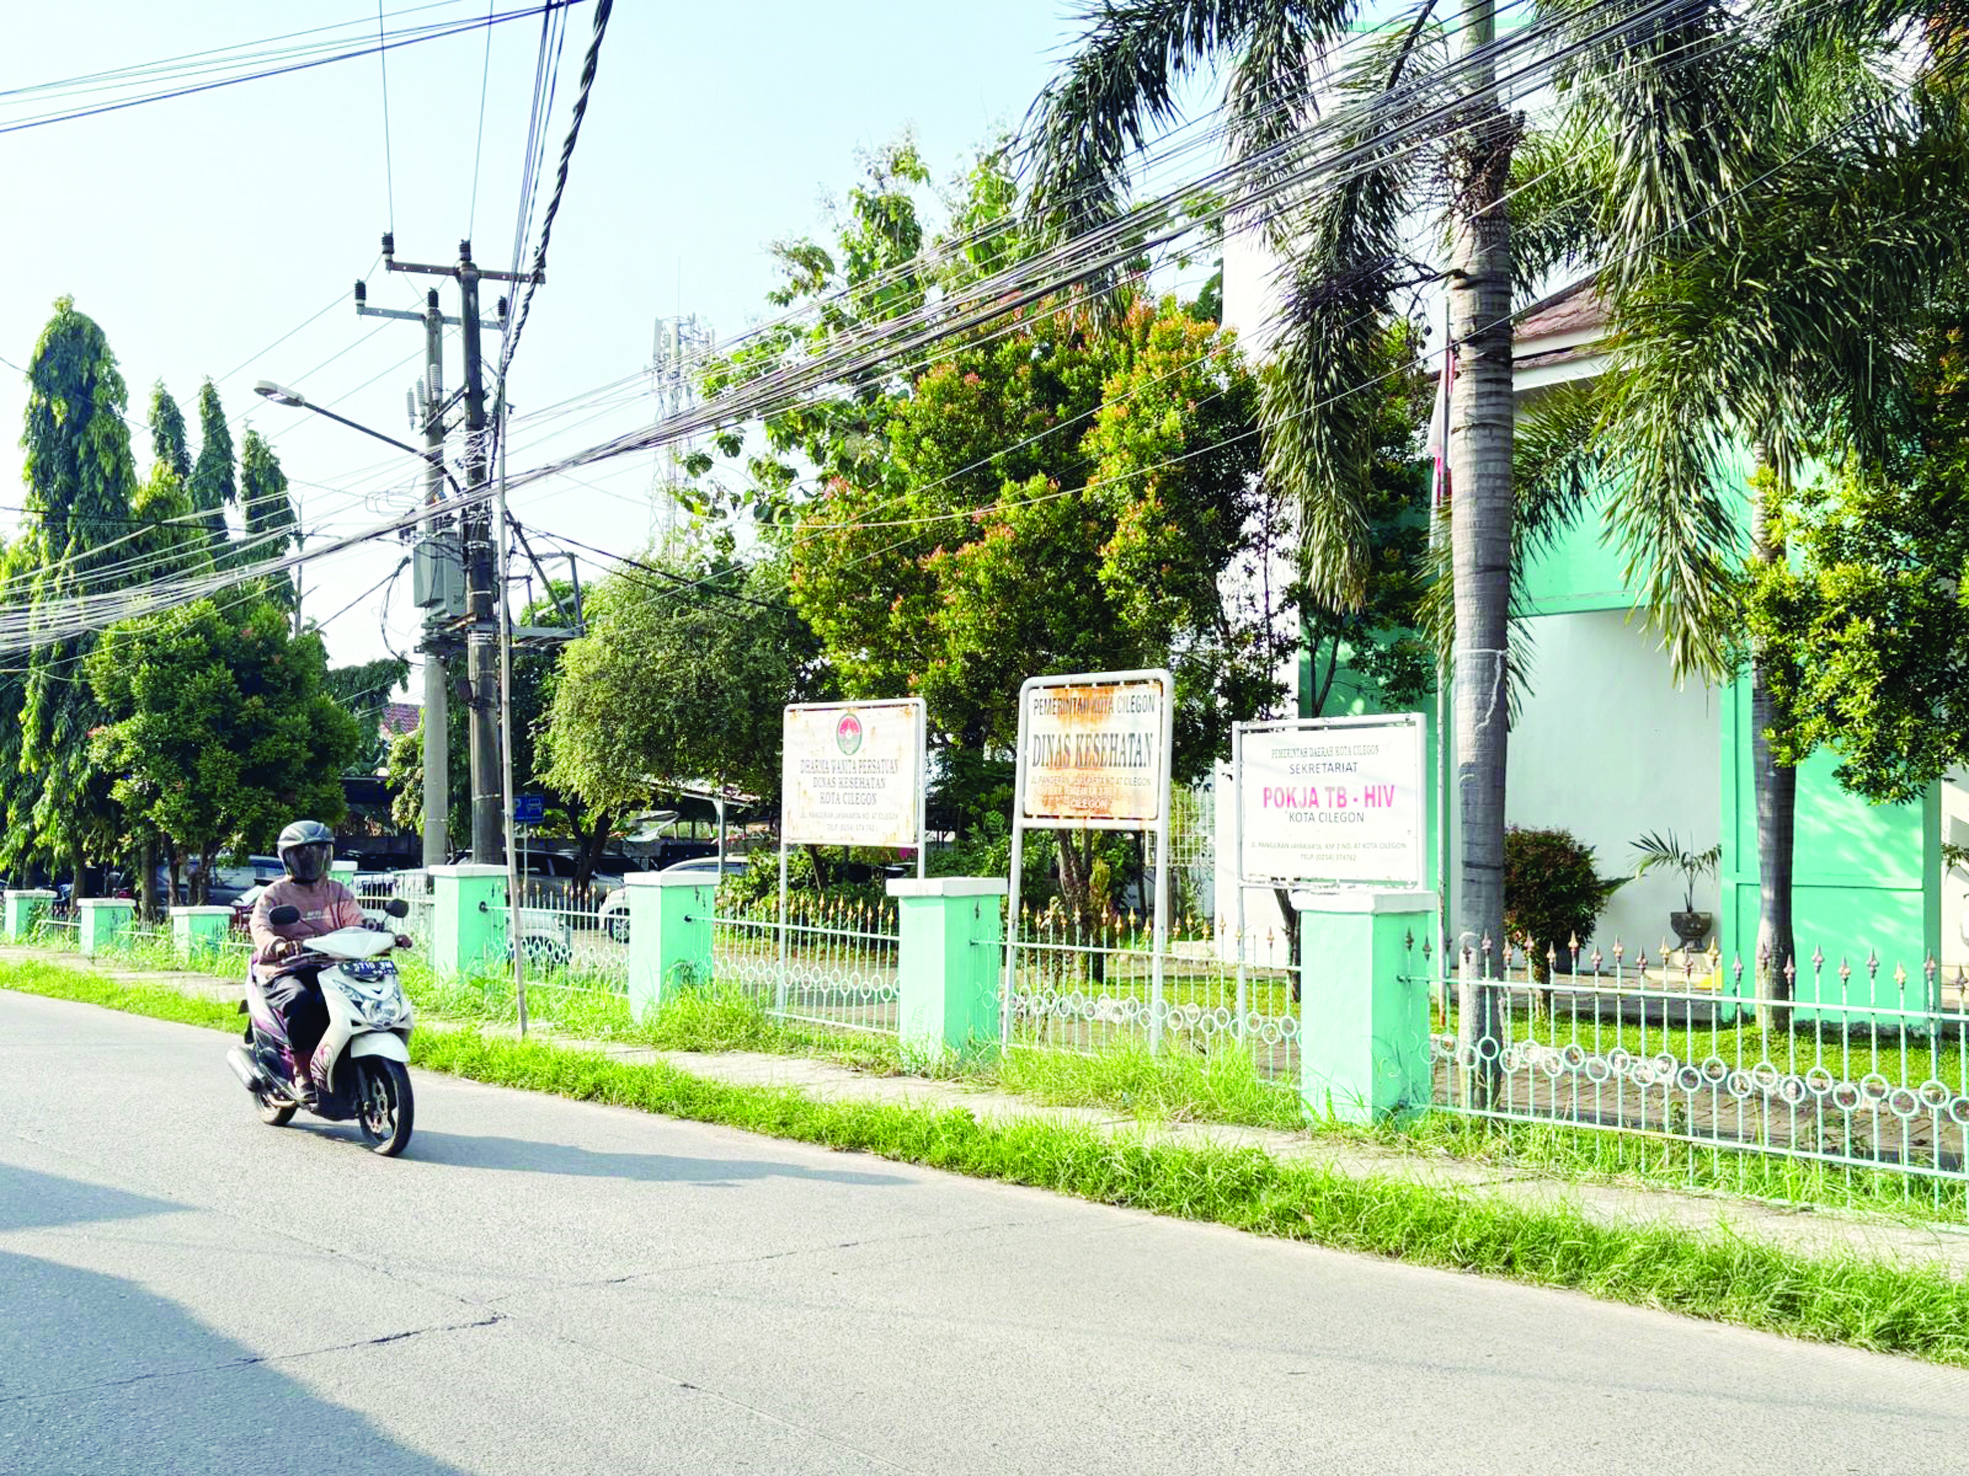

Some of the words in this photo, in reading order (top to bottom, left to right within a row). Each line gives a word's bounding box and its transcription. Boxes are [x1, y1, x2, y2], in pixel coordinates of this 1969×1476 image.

[1033, 697, 1088, 715] PEMERINTAH
[1091, 696, 1114, 714] KOTA
[1116, 694, 1155, 714] CILEGON
[1032, 733, 1071, 767] DINAS
[1075, 732, 1153, 768] KESEHATAN
[1335, 746, 1352, 757] KOTA
[1353, 744, 1379, 756] CILEGON
[800, 759, 829, 774] DHARMA
[830, 759, 857, 774] WANITA
[858, 758, 899, 774] PERSATUAN
[1289, 762, 1358, 774] SEKRETARIAT
[813, 777, 836, 788] DINAS
[838, 777, 886, 789] KESEHATAN
[819, 792, 841, 804] KOTA
[842, 792, 877, 805] CILEGON
[1263, 787, 1319, 808] POKJA
[1325, 786, 1347, 808] TB
[1364, 785, 1395, 807] HIV
[1289, 812, 1315, 823] KOTA
[1318, 812, 1365, 823] CILEGON
[1362, 842, 1378, 850] KOTA
[1379, 842, 1407, 850] CILEGON
